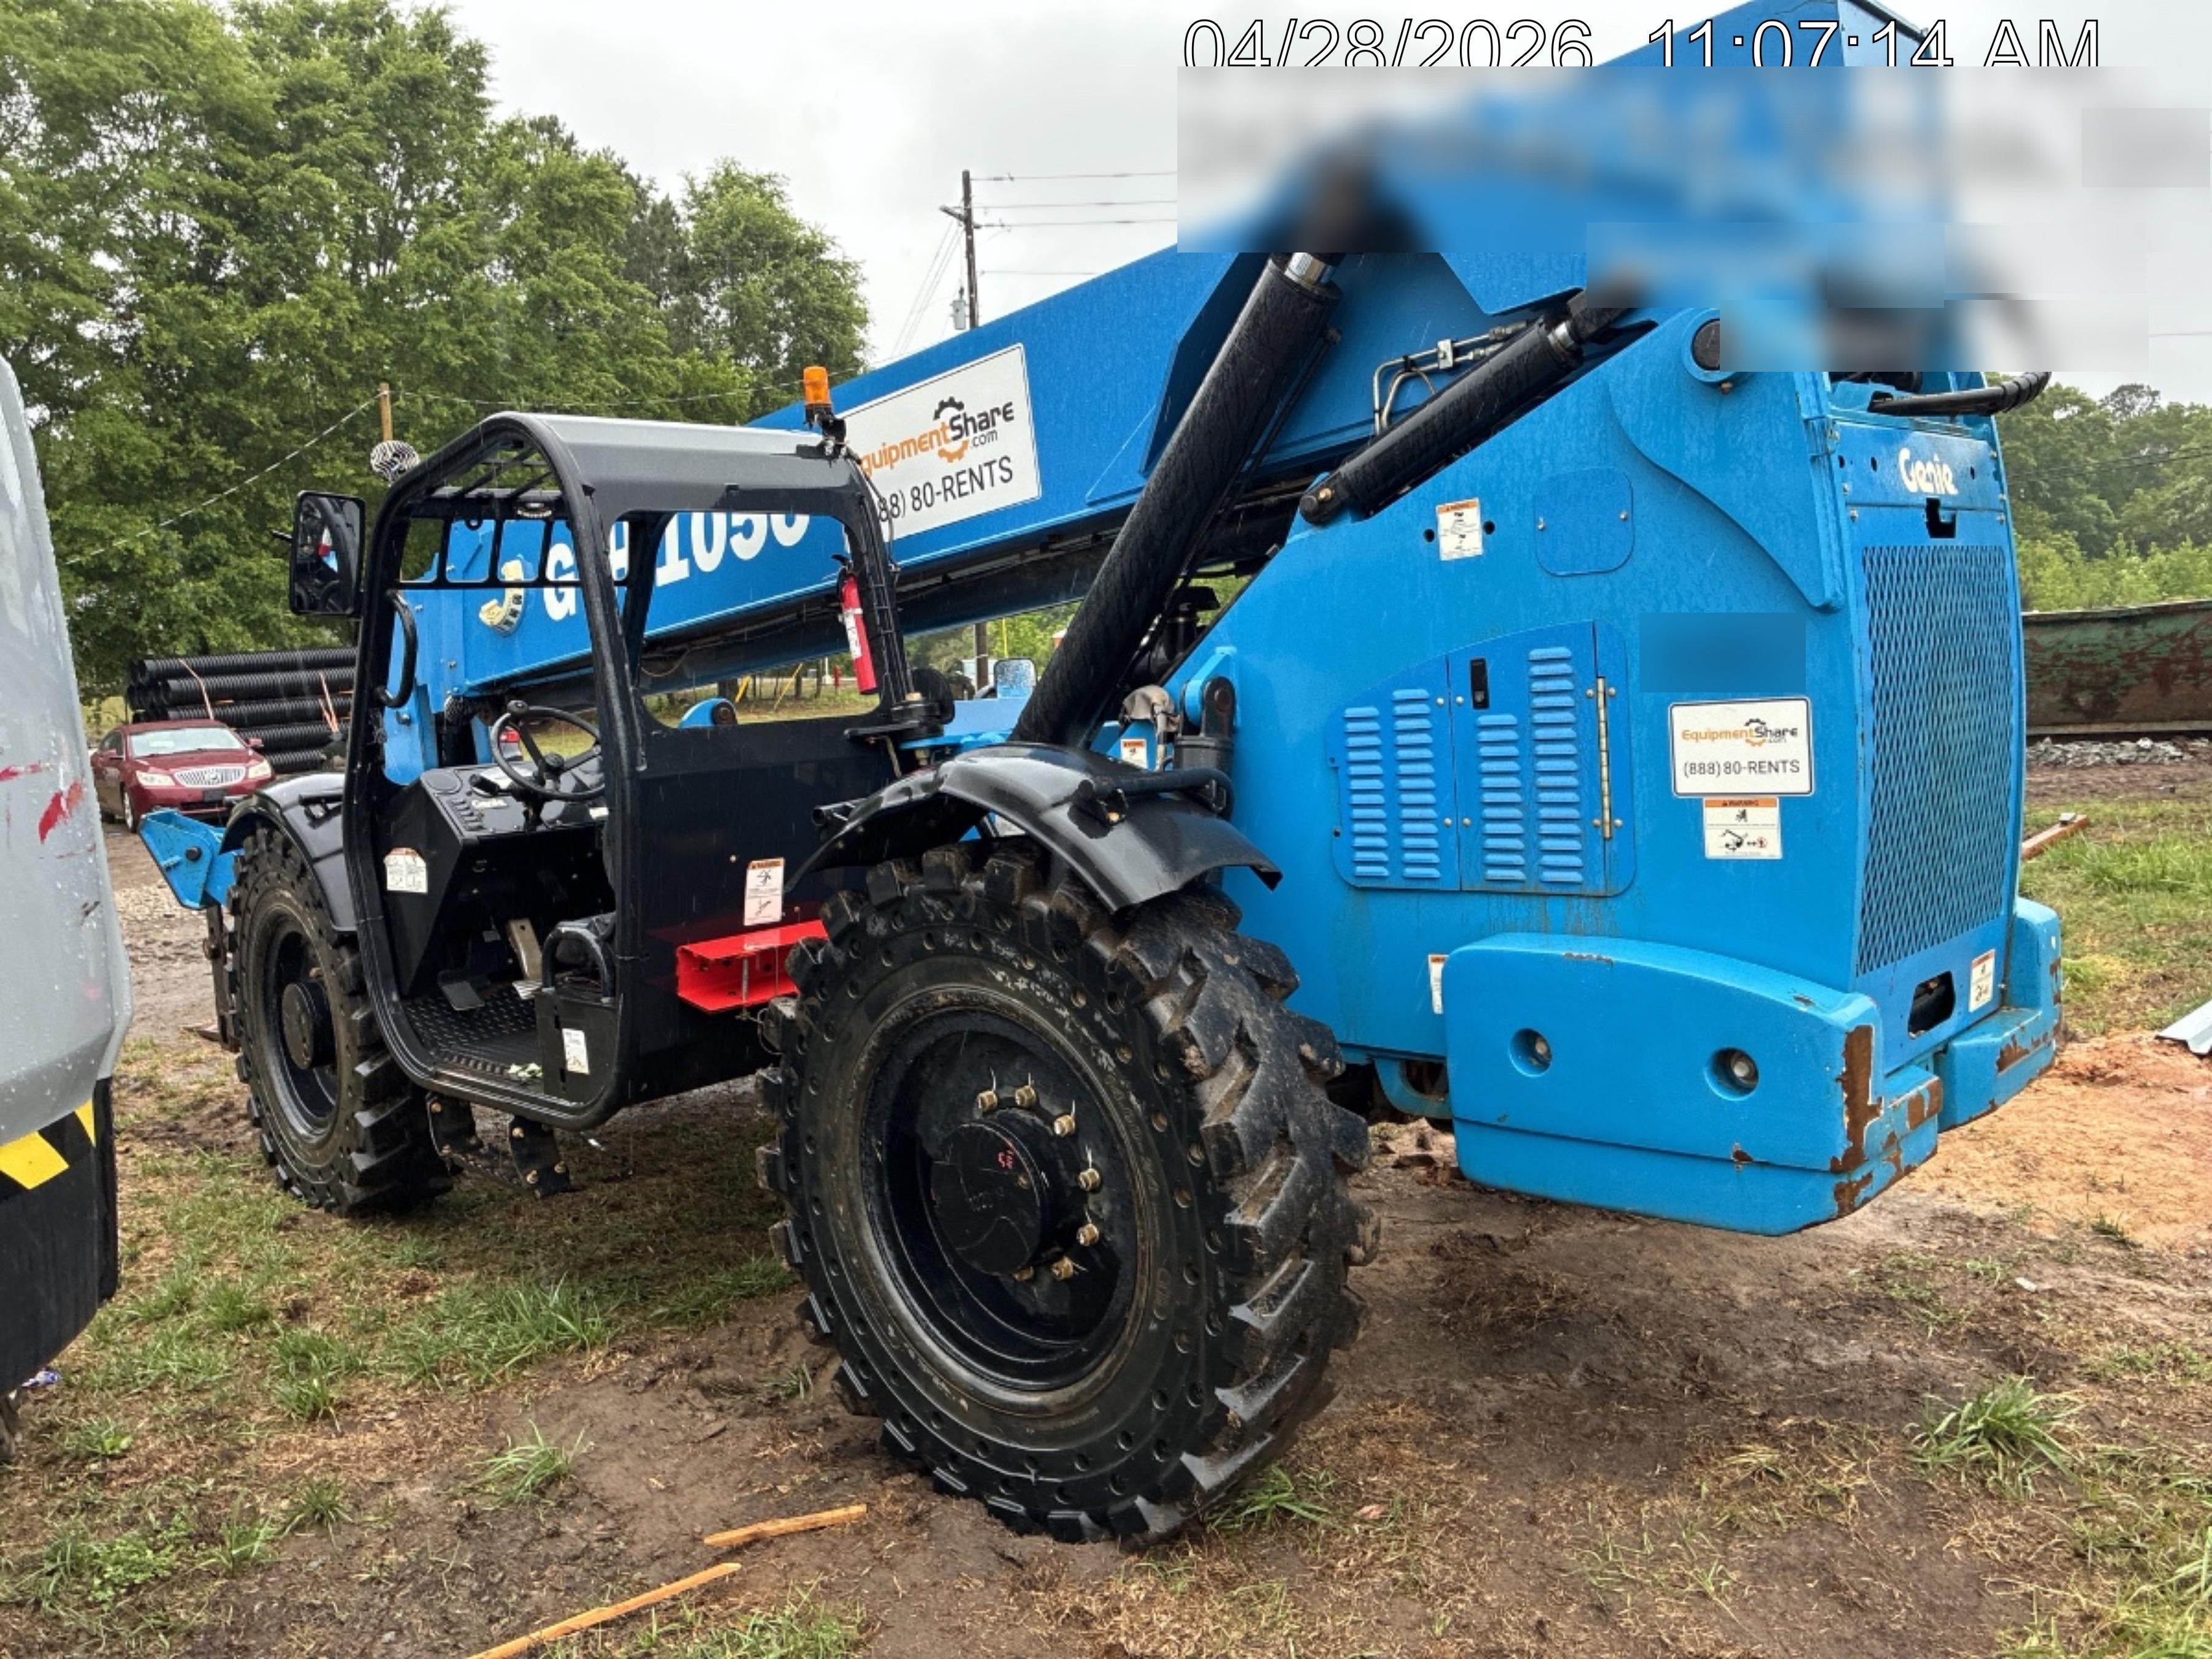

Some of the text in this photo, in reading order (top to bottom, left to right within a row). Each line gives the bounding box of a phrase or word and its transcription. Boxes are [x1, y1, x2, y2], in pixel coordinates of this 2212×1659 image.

[860, 401, 1015, 477] quipmentShare
[877, 455, 1014, 523] 88) 80-RENTS
[1898, 447, 1959, 495] Genie
[1681, 726, 1798, 743] EquipmentShare
[1723, 759, 1800, 775] 80-RENTS
